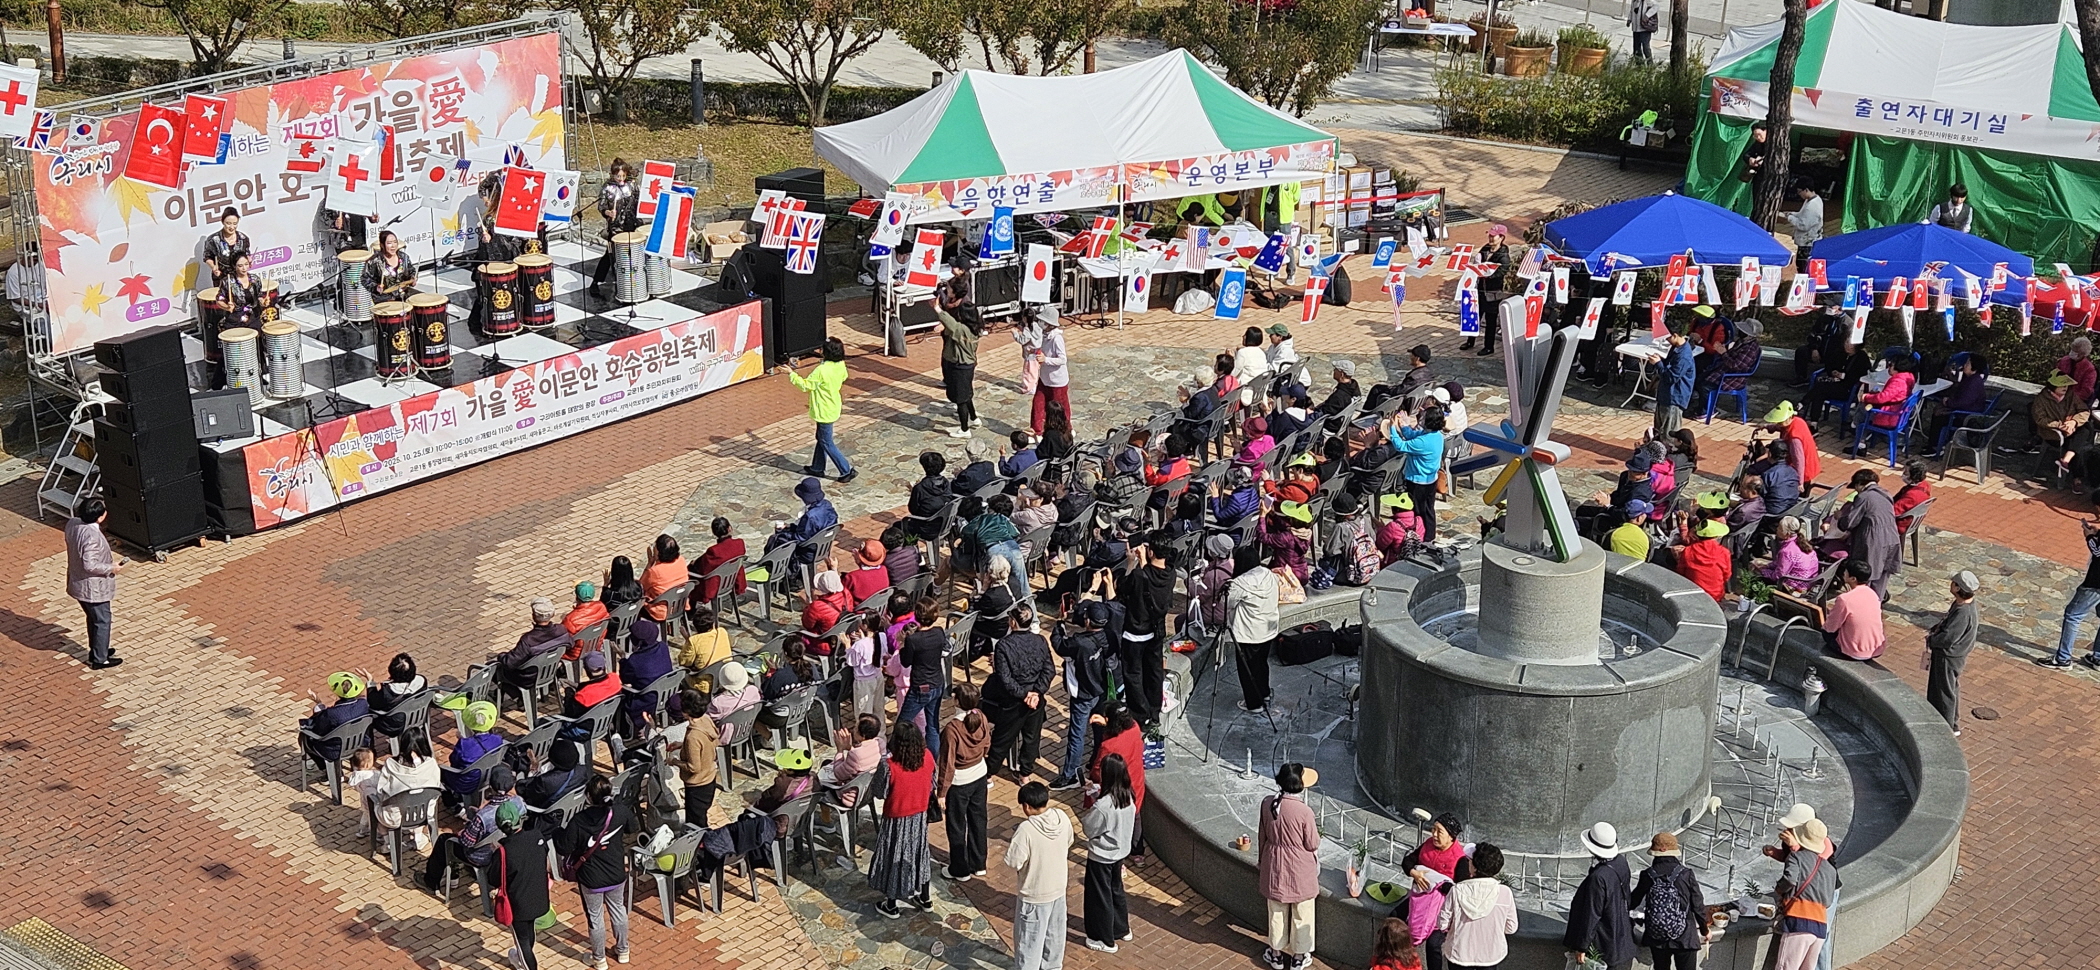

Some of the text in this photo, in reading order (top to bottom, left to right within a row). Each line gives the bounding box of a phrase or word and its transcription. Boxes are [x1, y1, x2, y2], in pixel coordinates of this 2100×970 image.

[354, 76, 467, 133] 가을 愛
[1854, 98, 2008, 134] 출연자대기실
[1917, 129, 1960, 140] 주민자치위원회
[1186, 158, 1275, 187] 운영본부
[164, 173, 267, 228] 이문안
[961, 180, 1057, 209] 음향연출
[689, 361, 706, 376] with
[329, 328, 716, 457] 시민과 함께하는 제7회 가을 愛 이문안 호수공원축제
